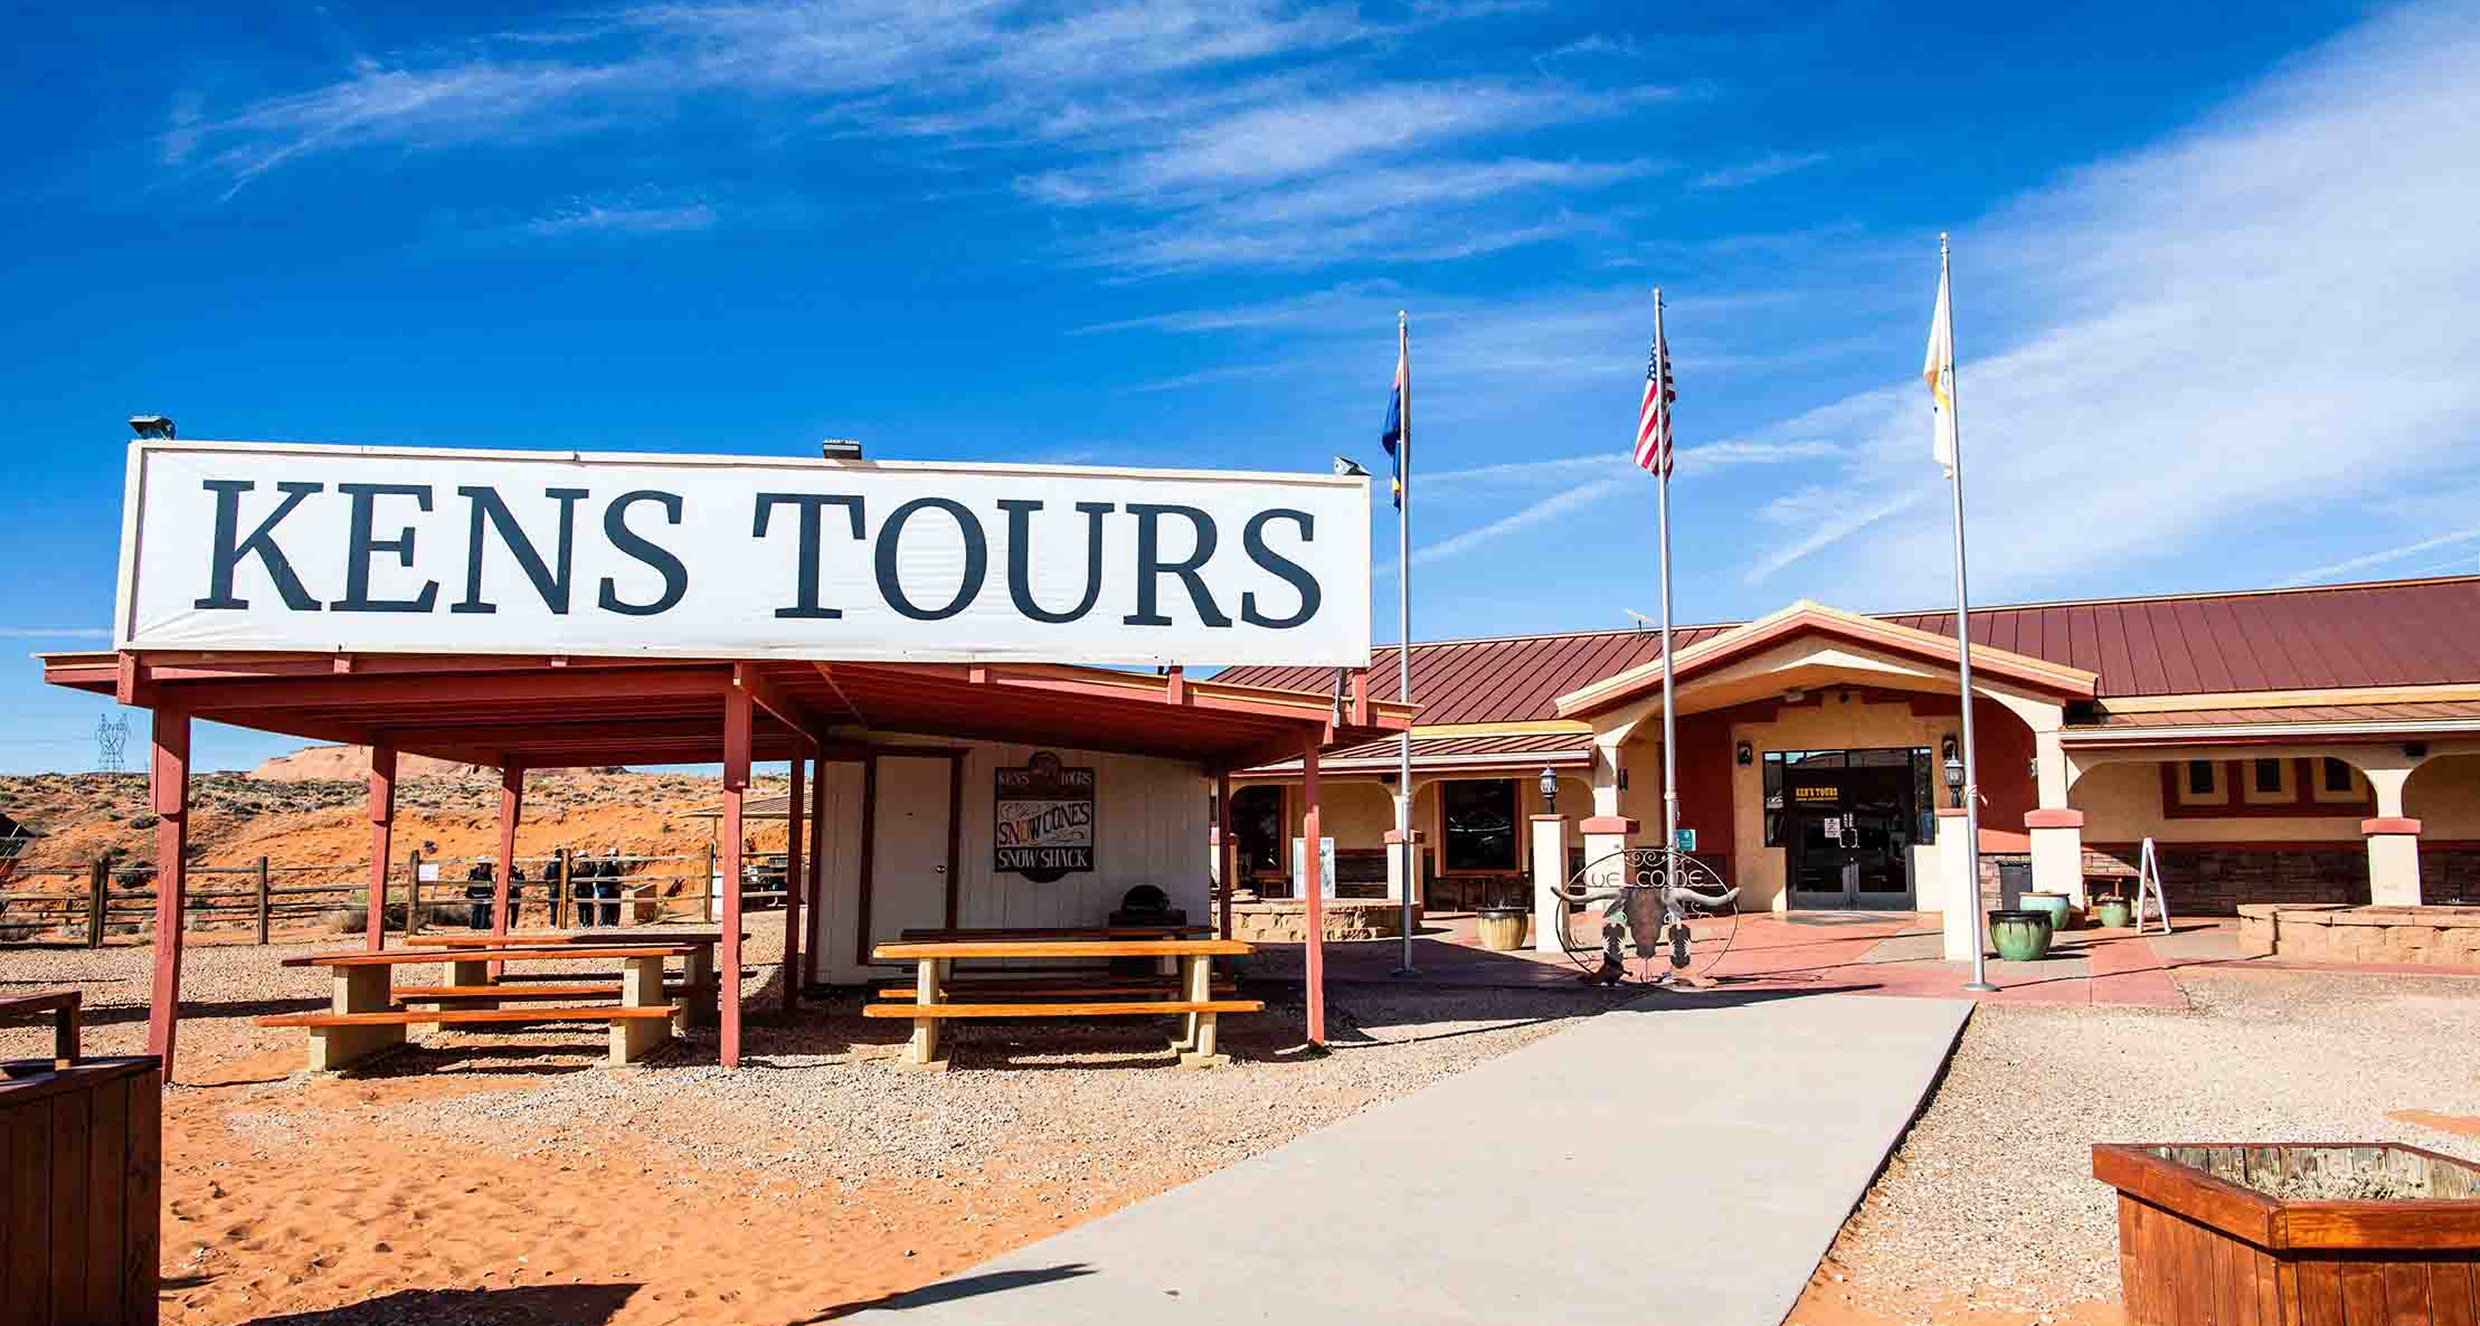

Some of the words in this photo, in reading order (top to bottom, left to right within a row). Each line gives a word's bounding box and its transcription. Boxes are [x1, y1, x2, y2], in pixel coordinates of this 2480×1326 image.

[194, 480, 689, 616] KENS
[752, 493, 1322, 629] TOURS
[999, 815, 1041, 846] SNOW
[1043, 802, 1091, 834] CONES
[999, 848, 1038, 868] SNOW
[1040, 848, 1088, 868] SHACK
[1583, 869, 1704, 888] WECOME
